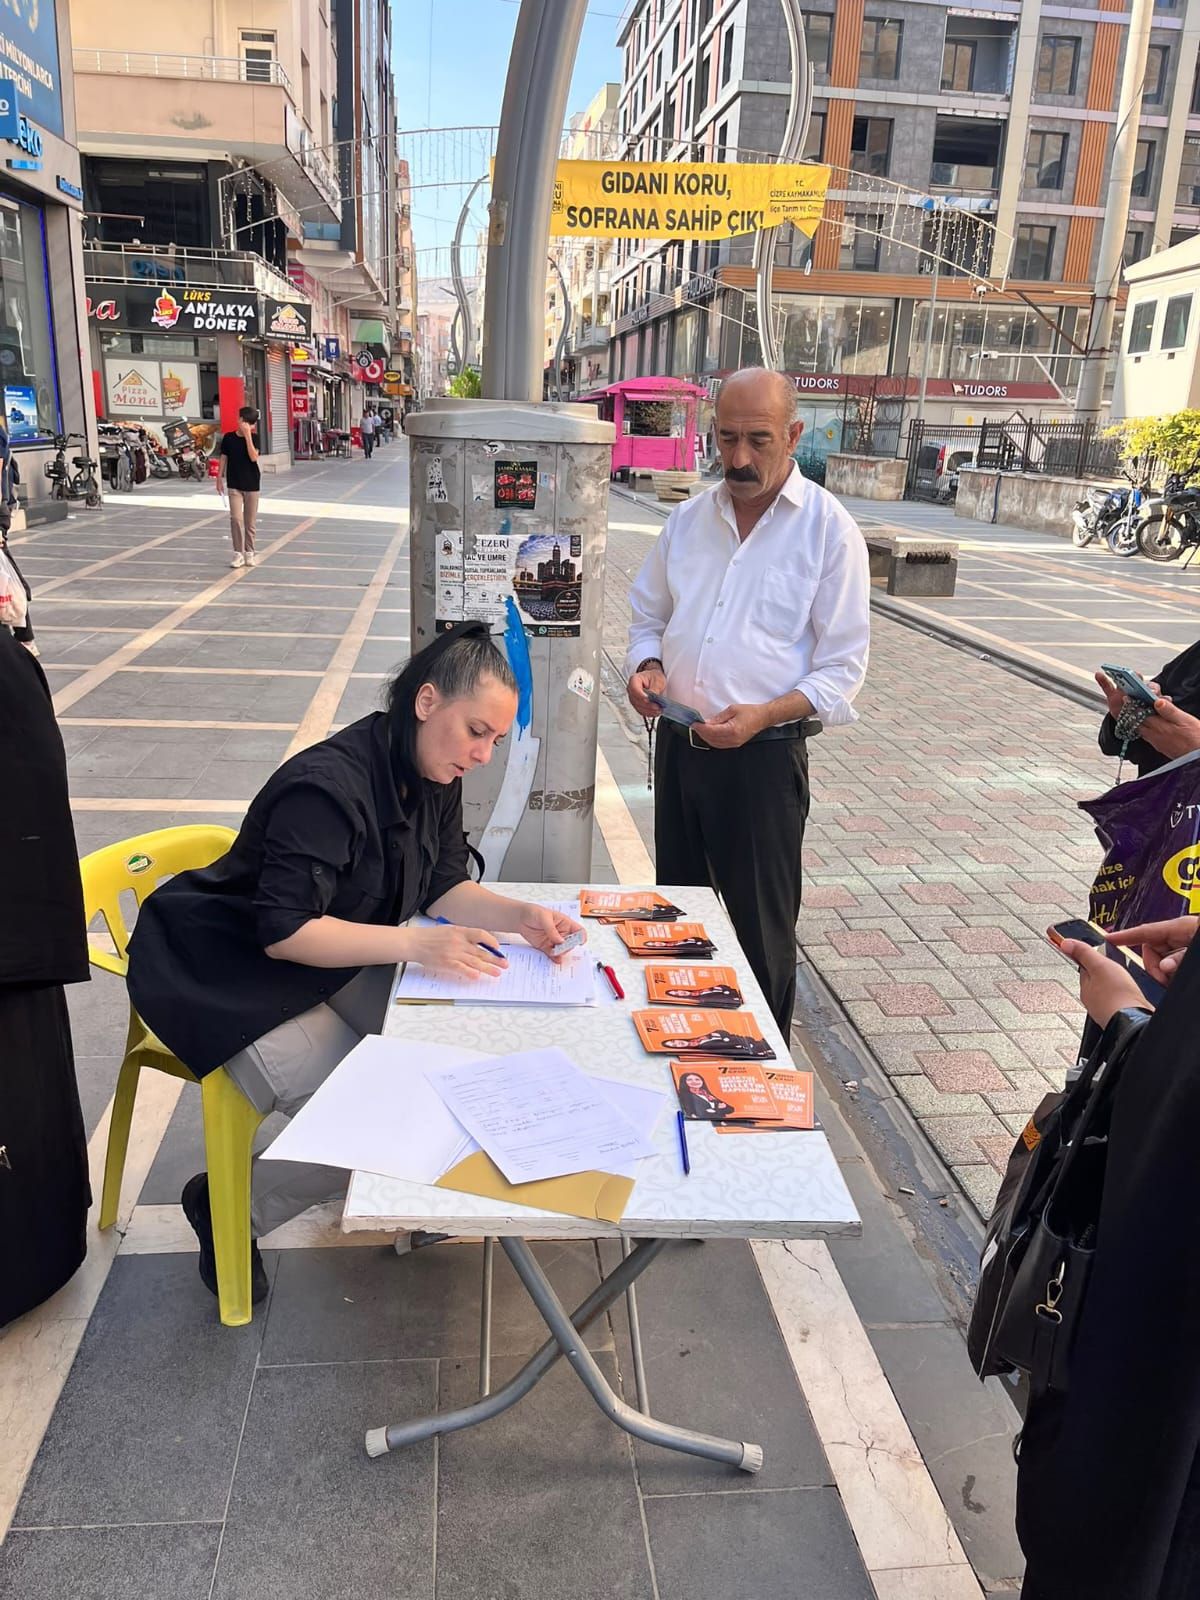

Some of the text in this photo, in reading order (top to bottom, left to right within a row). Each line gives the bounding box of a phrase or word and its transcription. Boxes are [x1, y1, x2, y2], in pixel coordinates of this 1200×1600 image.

[601, 171, 732, 200] GIDANI KORU,
[566, 204, 765, 235] SOFRANA SAHİP ÇIK!
[183, 289, 212, 301] LÜKS
[184, 301, 255, 318] ANTAKYA
[193, 314, 247, 332] DÖNER
[794, 376, 839, 389] TUDORS
[963, 384, 1008, 397] TUDORS
[113, 393, 159, 405] Mona
